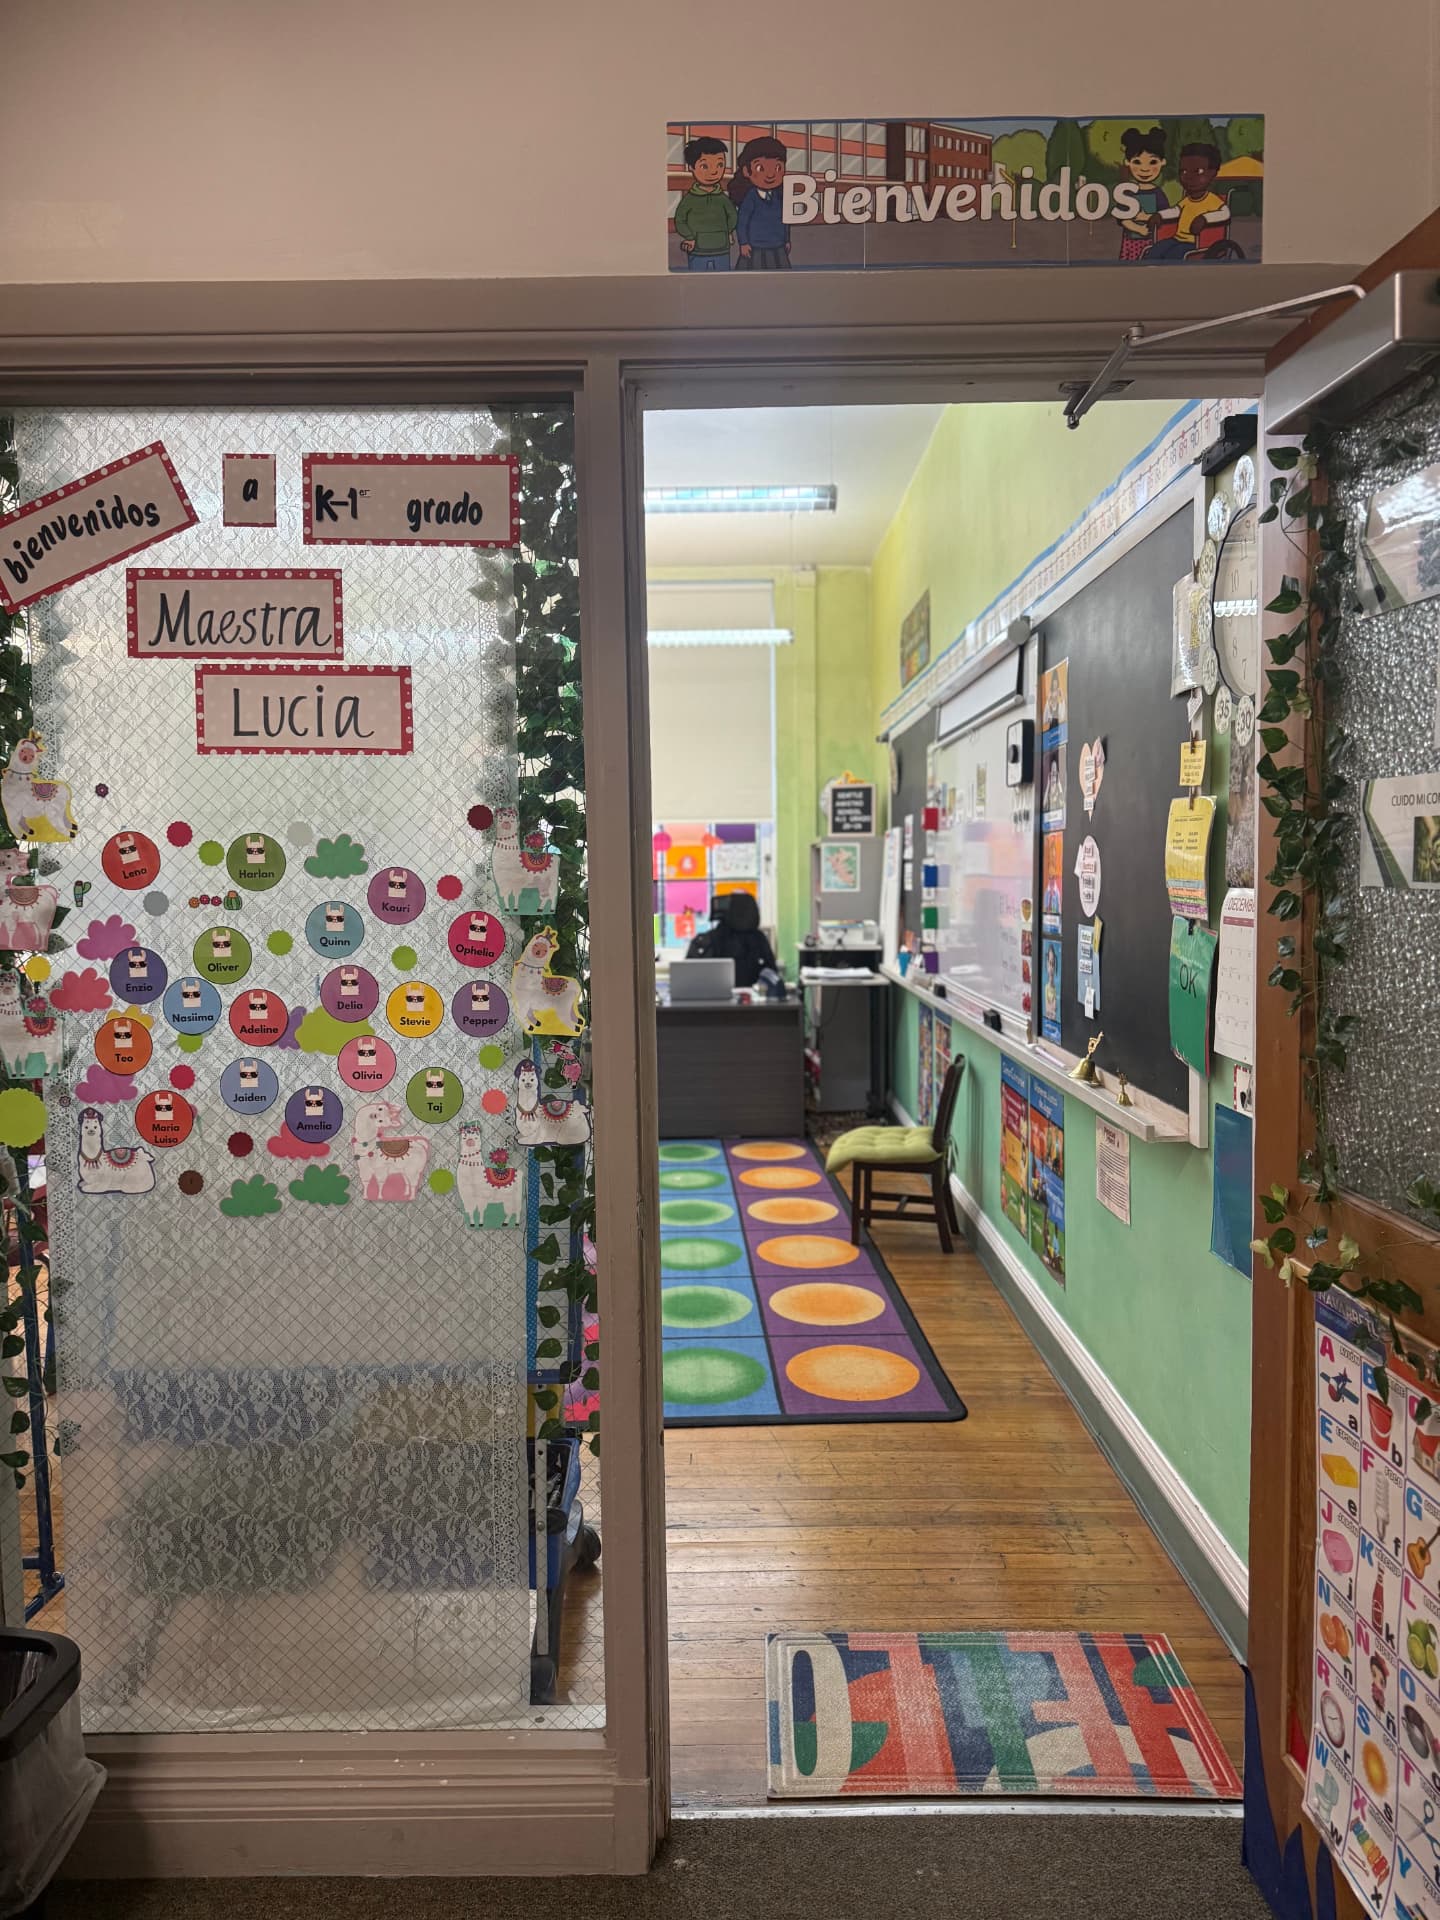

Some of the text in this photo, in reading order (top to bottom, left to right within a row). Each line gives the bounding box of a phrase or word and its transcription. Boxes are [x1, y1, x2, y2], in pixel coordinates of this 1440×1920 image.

[781, 166, 1143, 226] Bienvenidos
[242, 477, 259, 502] a
[407, 492, 483, 532] grado
[3, 494, 161, 585] bienvenidos
[148, 589, 332, 648] Maestra
[232, 684, 375, 739] Lucia
[1391, 793, 1415, 806] CUIDO
[1416, 793, 1426, 805] MI
[122, 867, 147, 880] Lena
[238, 869, 275, 879] Harlan
[381, 902, 411, 913] Kauri
[319, 936, 351, 947] Quinn
[455, 944, 495, 959] Ophelia
[207, 962, 239, 972] Oliver
[125, 983, 153, 992] Enzio
[1179, 964, 1198, 999] OK
[336, 1000, 363, 1010] Delia
[172, 1013, 214, 1023] Nasiima
[399, 1016, 431, 1026] Stevie
[462, 1016, 499, 1027] Pepper
[239, 1025, 279, 1034] Adeline
[114, 1053, 133, 1063] Teo
[352, 1071, 383, 1081] Olivia
[233, 1092, 267, 1103] Jaiden
[427, 1102, 443, 1114] Taj
[151, 1123, 180, 1133] Maria
[296, 1121, 333, 1131] Amelia
[154, 1135, 179, 1144] Luisa
[1320, 1335, 1335, 1363] A
[1320, 1416, 1333, 1443] E
[1348, 1413, 1358, 1433] a
[1362, 1448, 1375, 1473] F
[1392, 1443, 1402, 1467] b
[1321, 1501, 1333, 1524] J
[1348, 1499, 1358, 1517] e
[1407, 1487, 1422, 1521] G
[1361, 1532, 1374, 1566] K
[1393, 1537, 1401, 1557] f
[1318, 1575, 1331, 1607] N
[1404, 1576, 1416, 1610] L
[1356, 1620, 1370, 1656] Ñ
[1385, 1623, 1396, 1649] k
[1317, 1655, 1331, 1688] R
[1344, 1663, 1353, 1686] n
[1401, 1668, 1416, 1702] O
[1357, 1704, 1370, 1736] S
[1315, 1734, 1329, 1769] W
[1383, 1802, 1393, 1823] s
[1330, 1821, 1343, 1847] w
